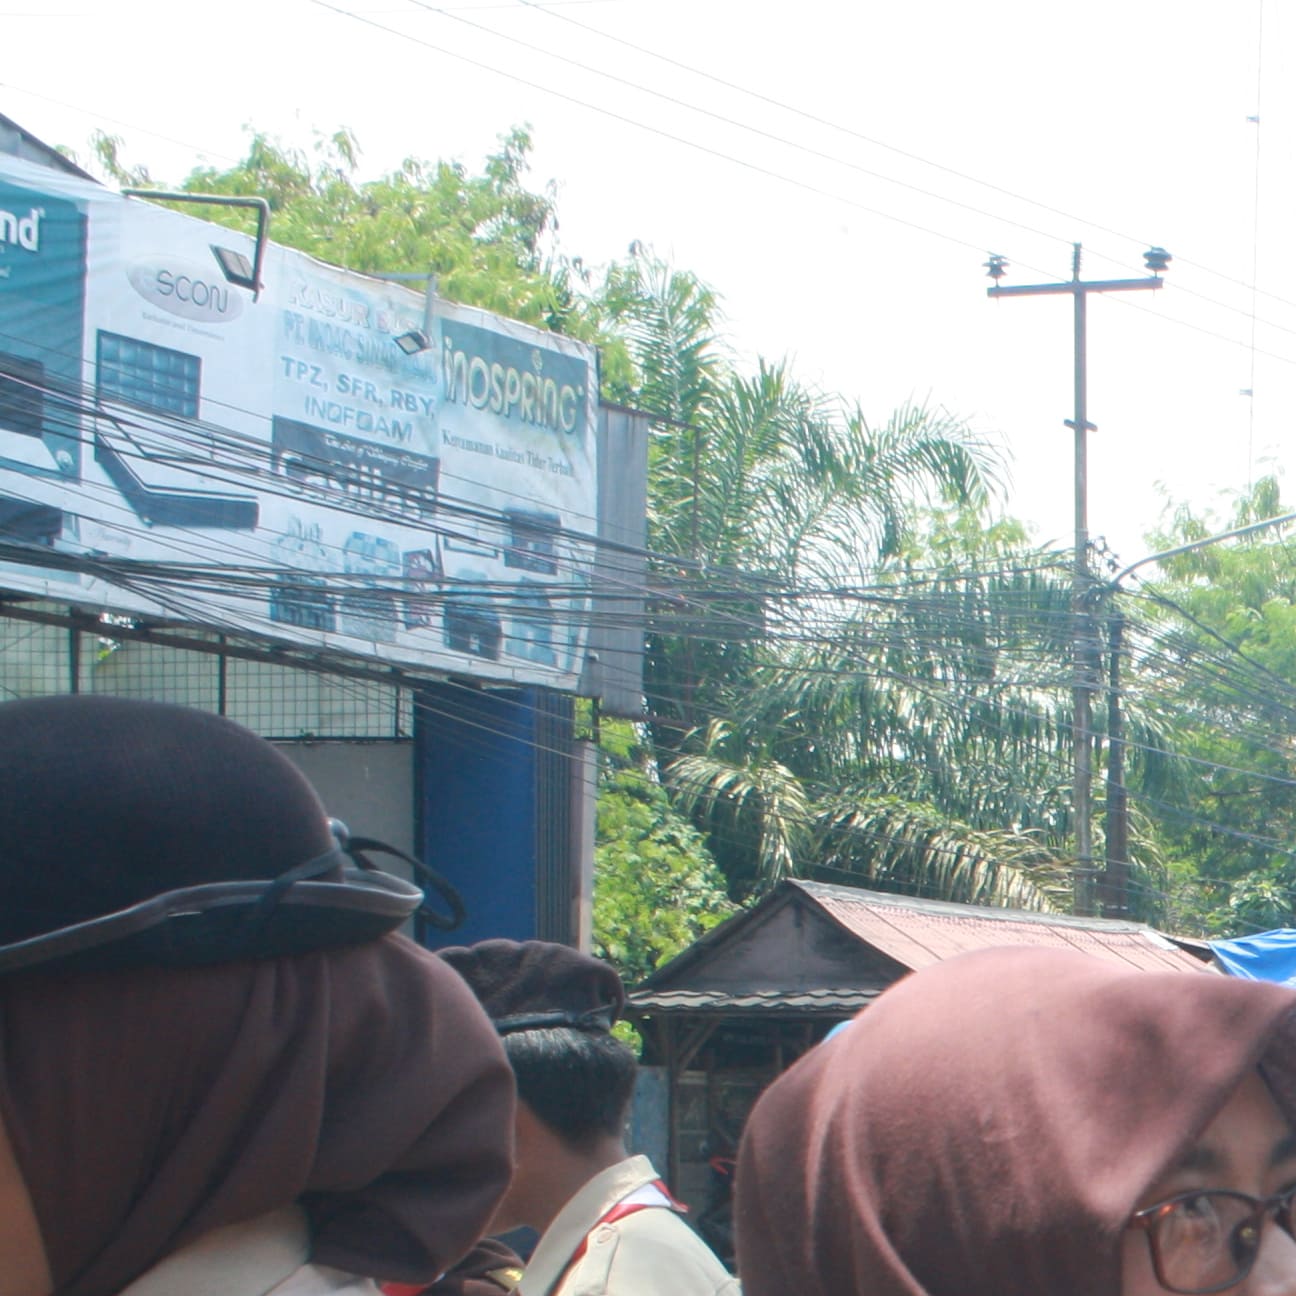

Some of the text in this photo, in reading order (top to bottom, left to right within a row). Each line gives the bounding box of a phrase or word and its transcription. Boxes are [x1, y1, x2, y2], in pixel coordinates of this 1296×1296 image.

[281, 356, 328, 392] TPZ,
[336, 374, 384, 407] SFR,
[390, 389, 437, 420] RBY,
[304, 395, 413, 443] INOFOAM
